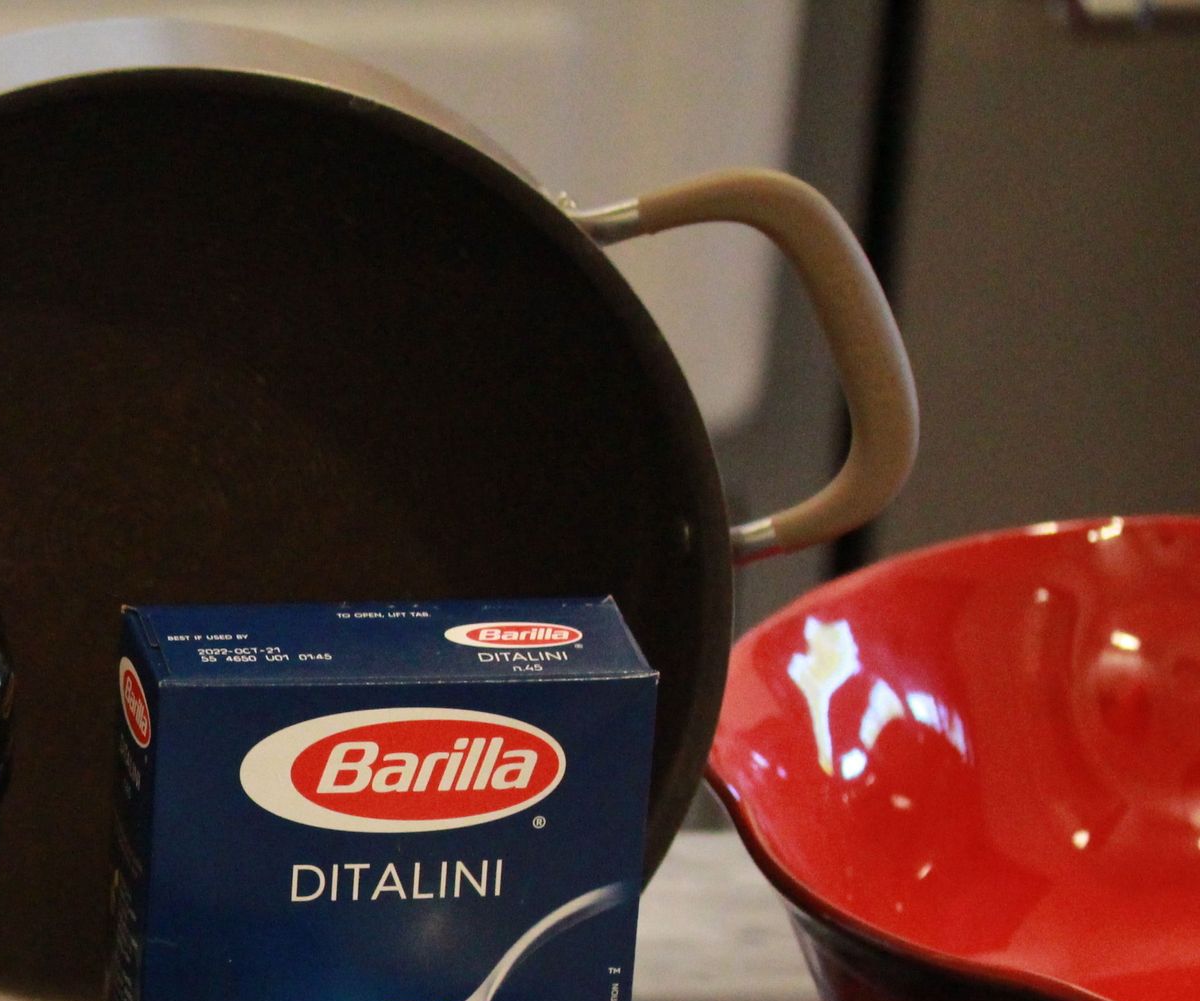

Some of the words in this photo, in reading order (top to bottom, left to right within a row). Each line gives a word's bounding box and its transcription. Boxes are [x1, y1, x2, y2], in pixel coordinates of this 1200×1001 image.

[478, 627, 570, 641] Barilla
[197, 647, 281, 656] 2022-OCT-21
[477, 651, 568, 663] DITALINI
[201, 655, 217, 663] 55
[225, 655, 257, 663] 4650
[512, 664, 543, 672] n.45
[124, 675, 148, 737] Barilla
[316, 736, 539, 794] Barilla
[290, 859, 504, 902] DITALINI
